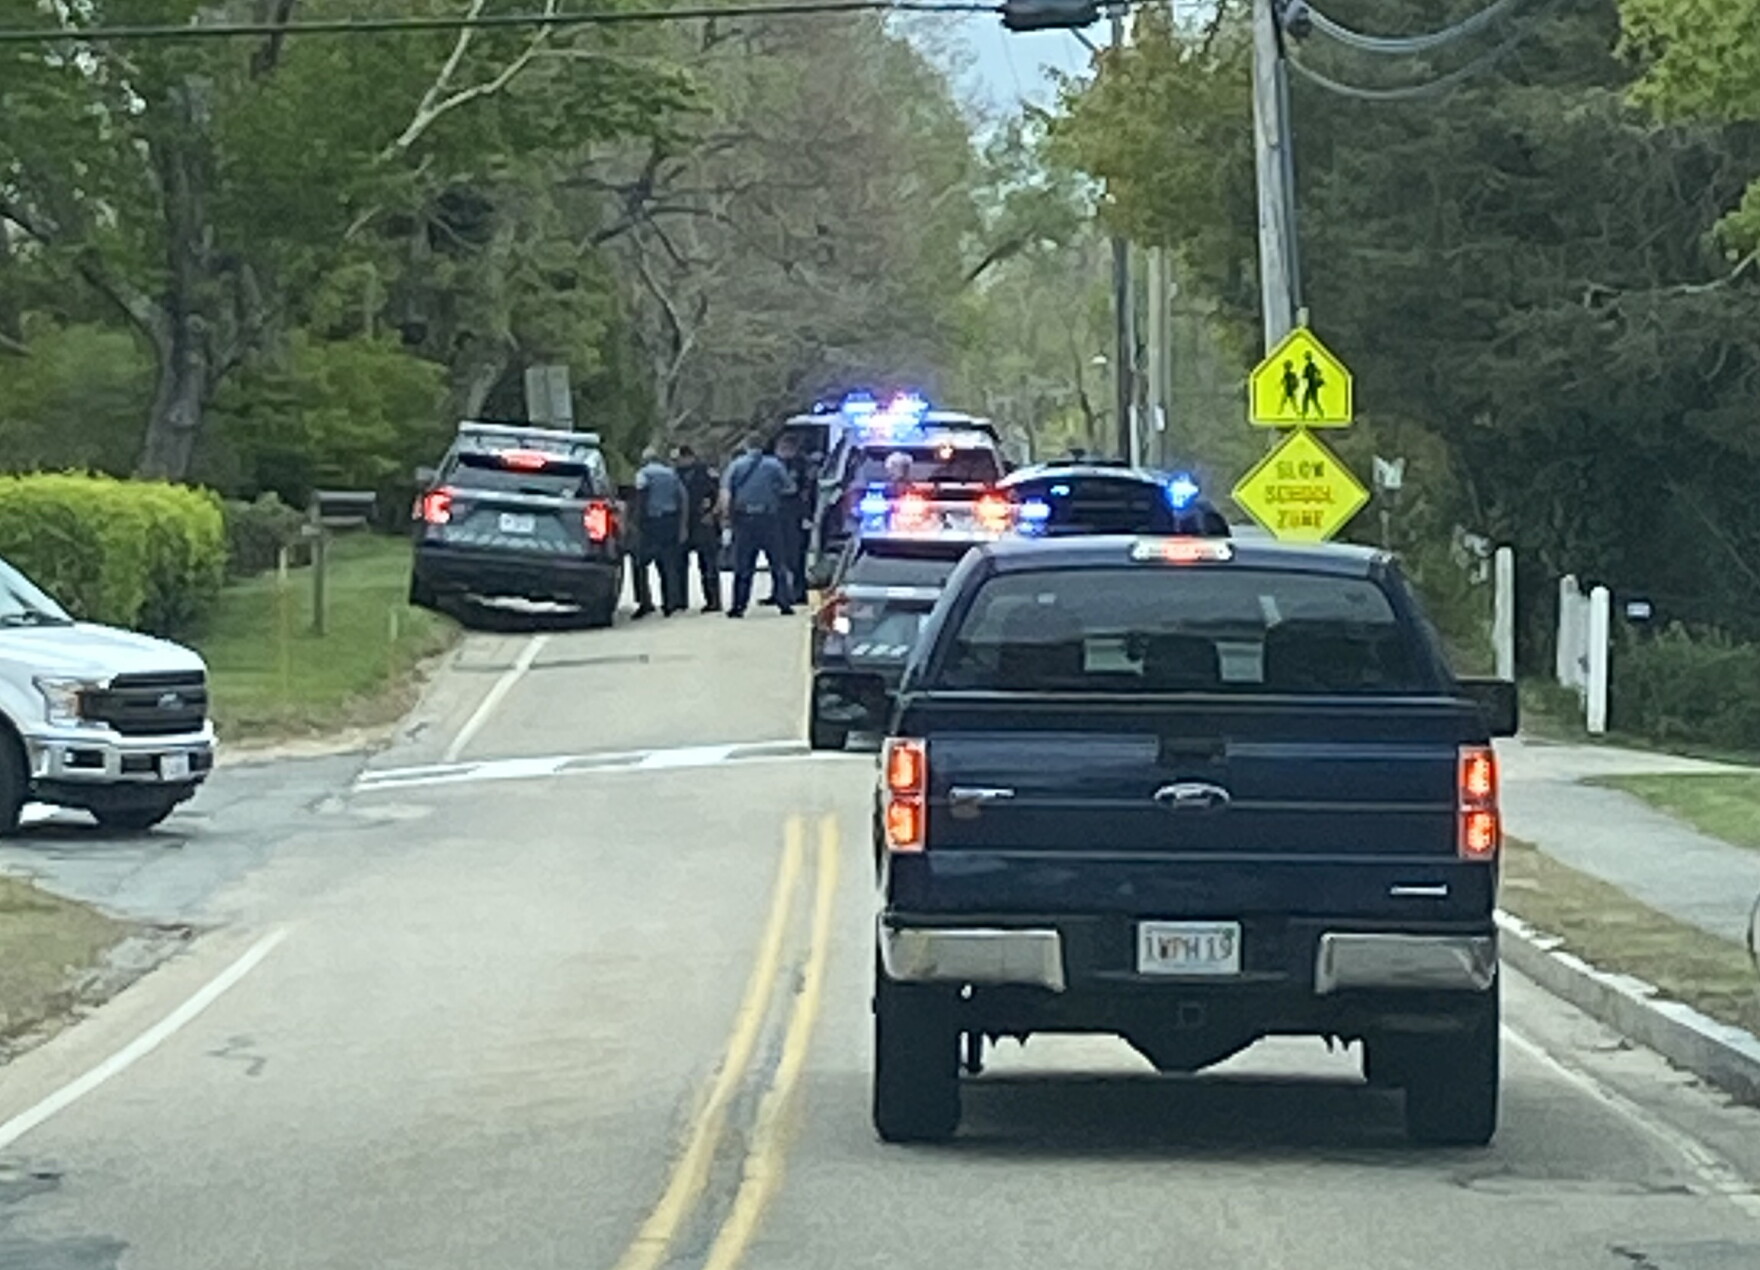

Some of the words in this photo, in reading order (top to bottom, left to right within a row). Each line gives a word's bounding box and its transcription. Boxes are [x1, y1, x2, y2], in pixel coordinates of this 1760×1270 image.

[1276, 460, 1325, 479] SLOW
[1264, 485, 1336, 504] SCHOOL
[1276, 509, 1325, 529] ZONE
